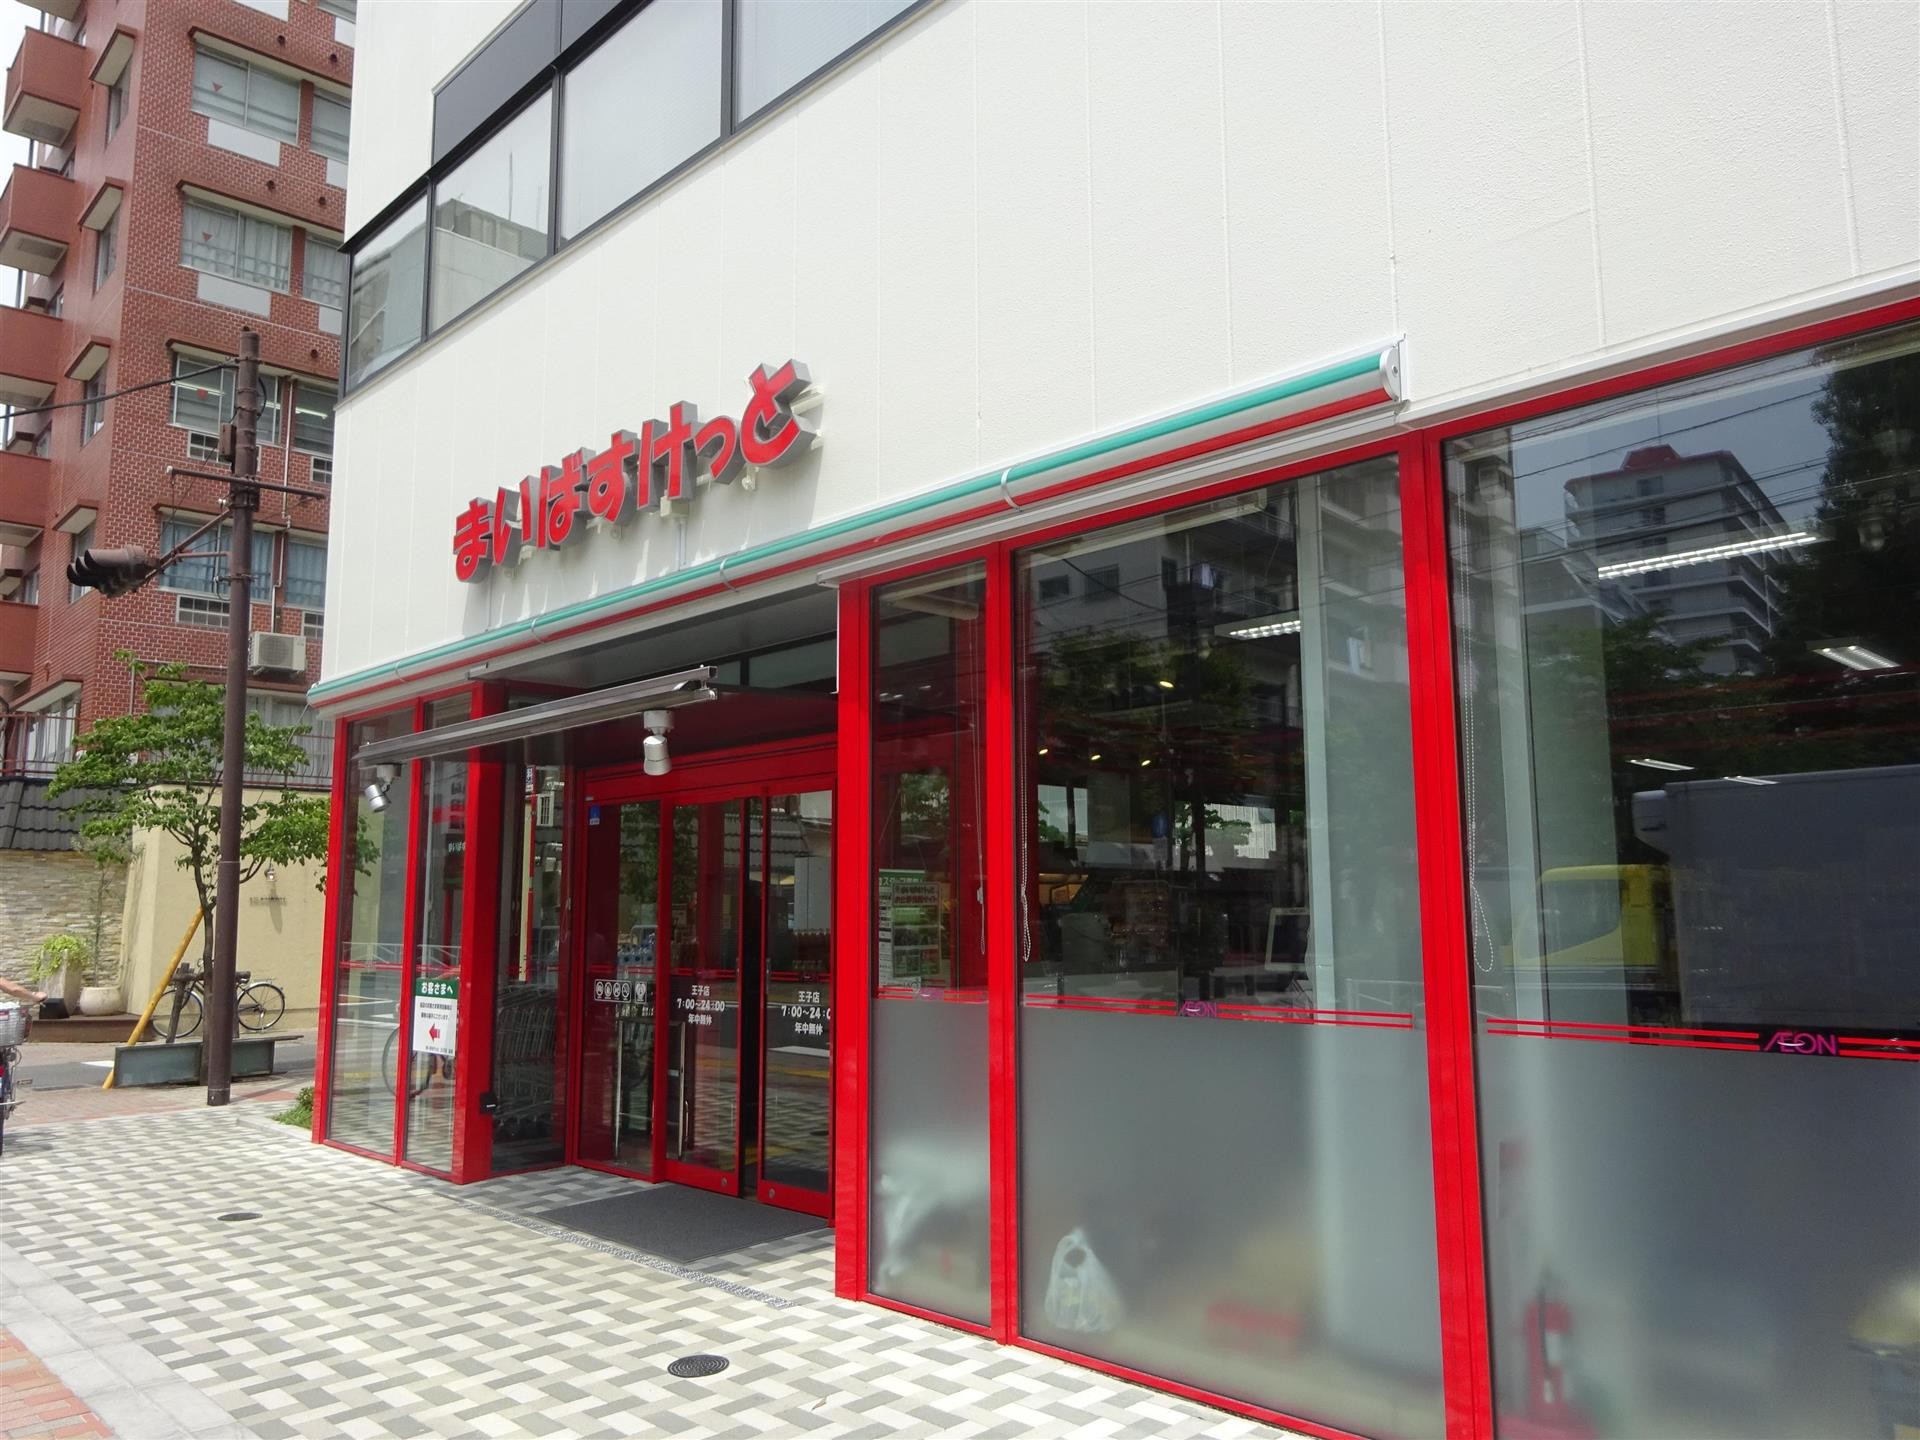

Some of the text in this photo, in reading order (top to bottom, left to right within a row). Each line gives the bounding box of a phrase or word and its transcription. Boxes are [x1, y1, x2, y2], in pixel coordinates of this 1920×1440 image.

[453, 358, 814, 583] まいばすけっと
[421, 981, 453, 995] お客さまへ
[691, 985, 710, 996] 王子店
[798, 990, 820, 1004] 王子店
[794, 1021, 823, 1036] 年中無休
